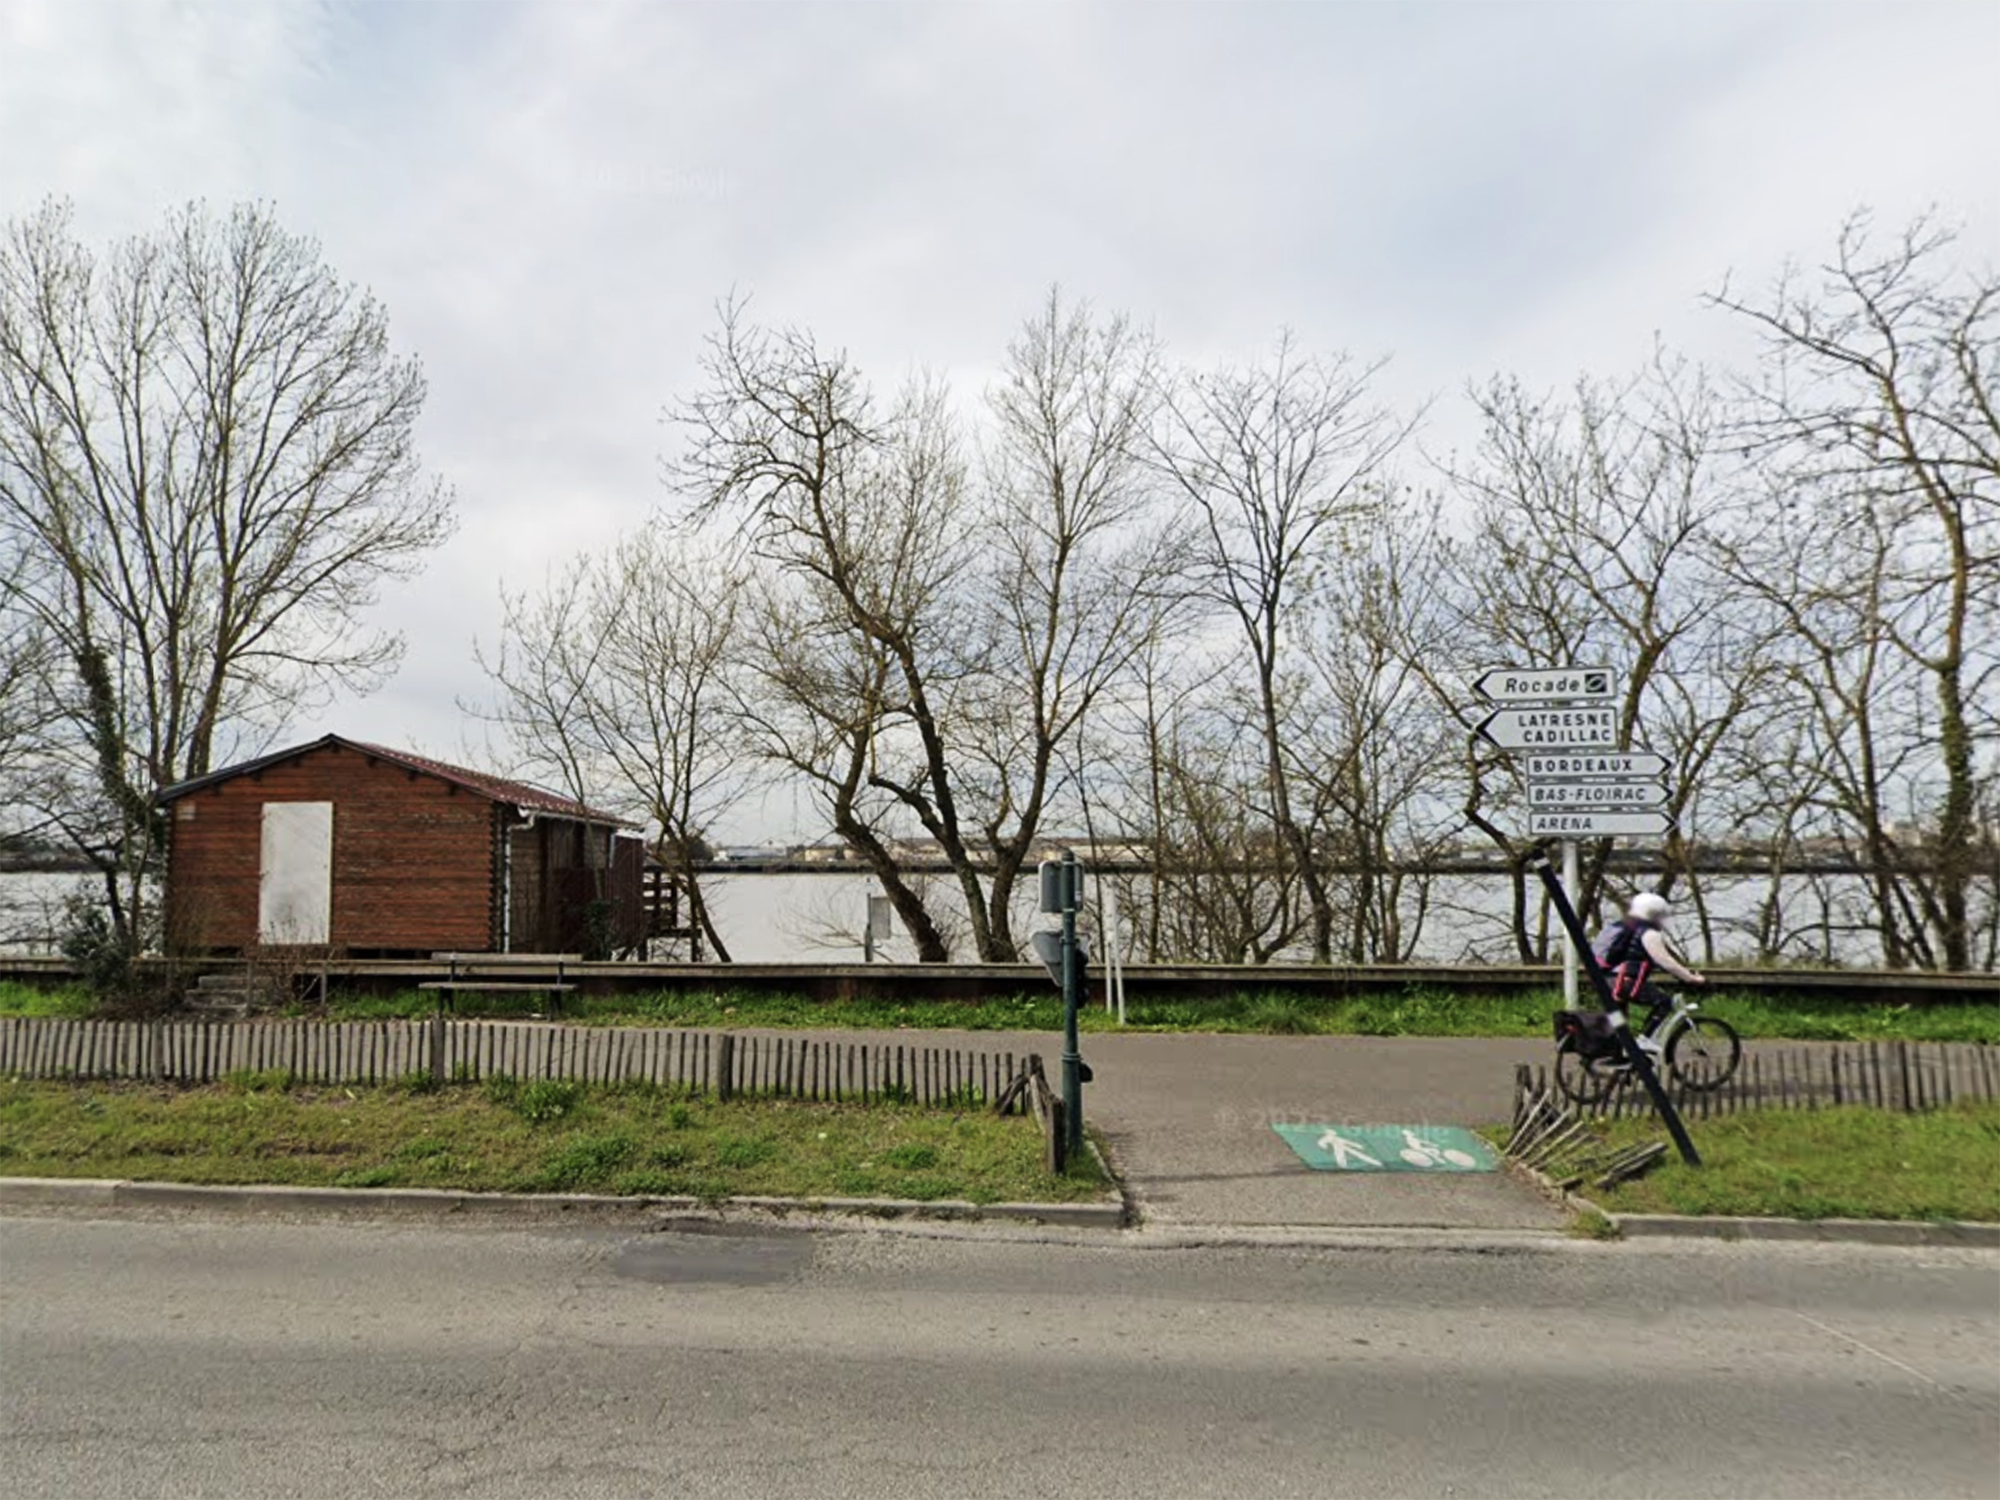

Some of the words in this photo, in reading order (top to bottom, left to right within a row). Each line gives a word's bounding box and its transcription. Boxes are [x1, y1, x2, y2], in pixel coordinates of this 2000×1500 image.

[1504, 677, 1580, 693] Rocade
[1518, 713, 1610, 727] LATRESNE
[1523, 729, 1611, 743] CADILLAC
[1533, 759, 1632, 773] BORDEAUX
[1535, 788, 1646, 801] BAS-FLOIRAC
[1537, 817, 1592, 830] ARENA
